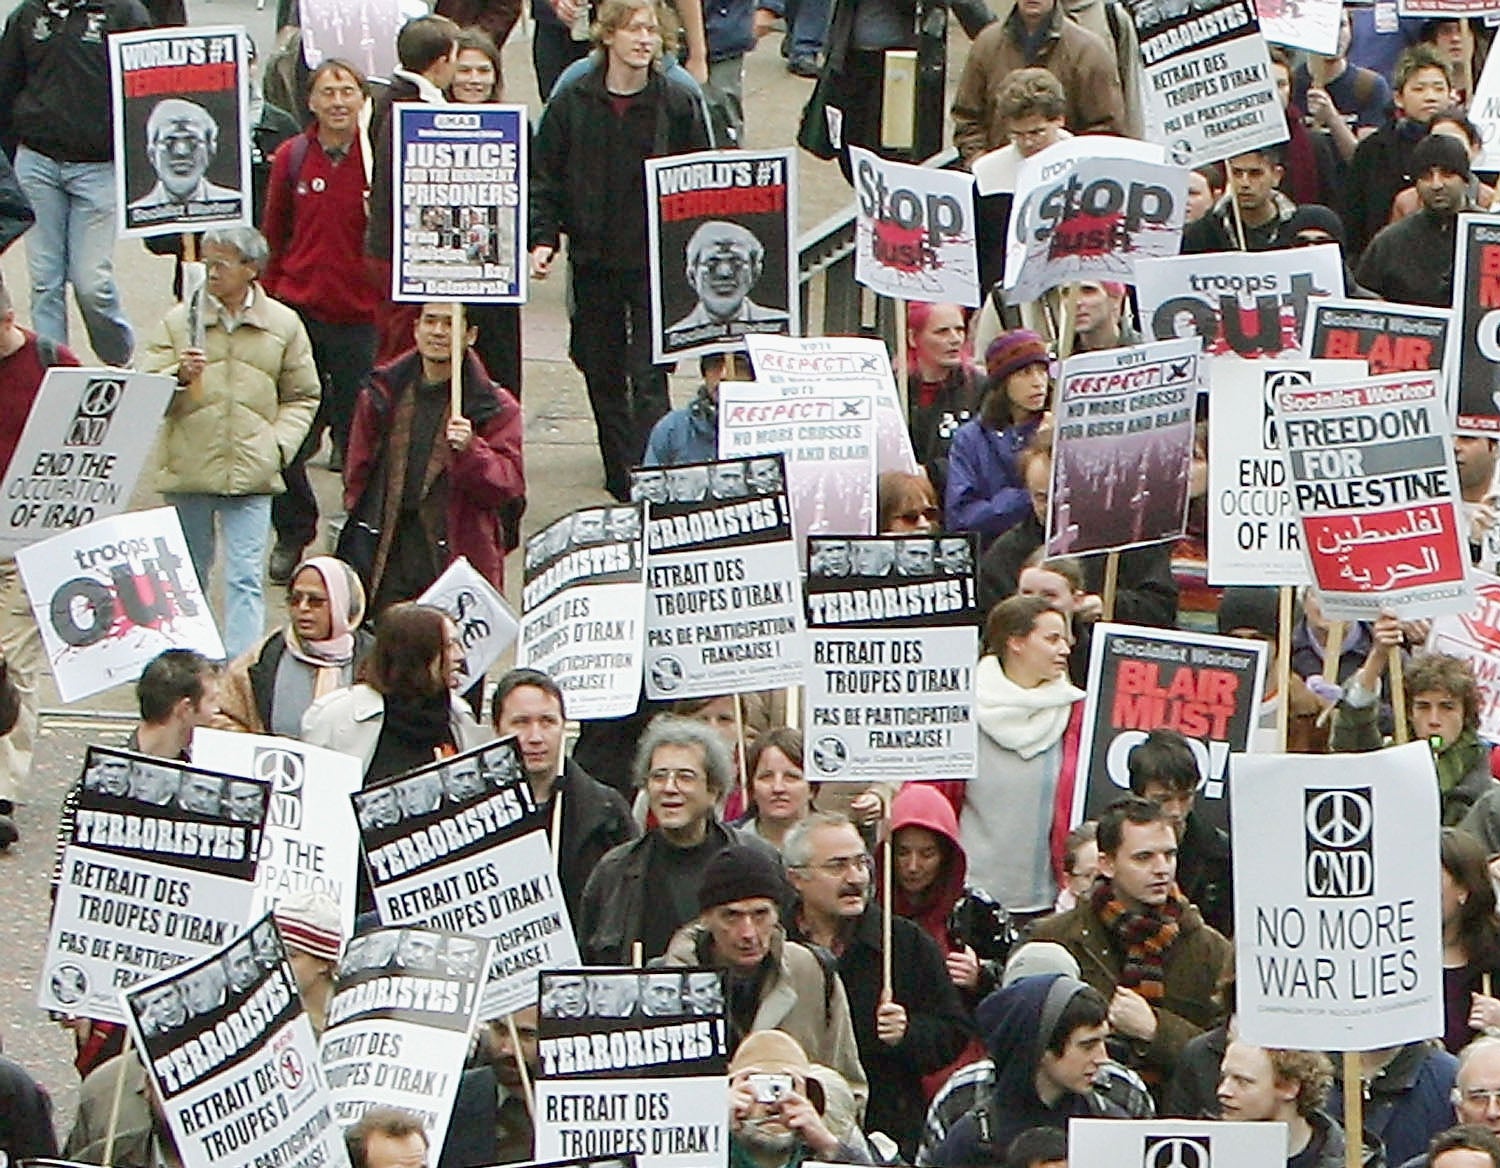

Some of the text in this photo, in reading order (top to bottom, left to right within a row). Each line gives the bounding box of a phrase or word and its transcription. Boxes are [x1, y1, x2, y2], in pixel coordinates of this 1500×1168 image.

[405, 143, 516, 168] JUSTICE
[403, 184, 518, 206] PRISONERS
[858, 158, 965, 244] Stop
[1189, 271, 1277, 293] troops
[1151, 273, 1329, 352] out
[1066, 368, 1161, 398] RESPECT
[1281, 381, 1435, 411] Socialist Worker
[726, 403, 833, 423] RESPECT
[1066, 389, 1187, 418] NO MORE CROSSES
[1285, 408, 1430, 448] FREEDOM
[33, 453, 117, 479] END THE
[1303, 448, 1364, 479] FOR
[9, 476, 122, 505] OCCUPATION
[1295, 472, 1451, 512] PALESTINE
[10, 503, 42, 528] OF
[73, 536, 150, 570] troops
[49, 536, 199, 648] out
[808, 584, 963, 624] TERRORISTES
[813, 640, 923, 665] RETRAIT DES
[1111, 639, 1251, 670] Socialist Worker
[1114, 659, 1240, 700] BLAIR
[76, 808, 246, 861] TERRORISTES
[70, 860, 190, 907] RETRAIT DES
[1305, 850, 1373, 898] CND
[1256, 899, 1416, 952] NO MORE
[1256, 949, 1420, 1001] WAR LIES
[157, 983, 291, 1092] TERRORISTES
